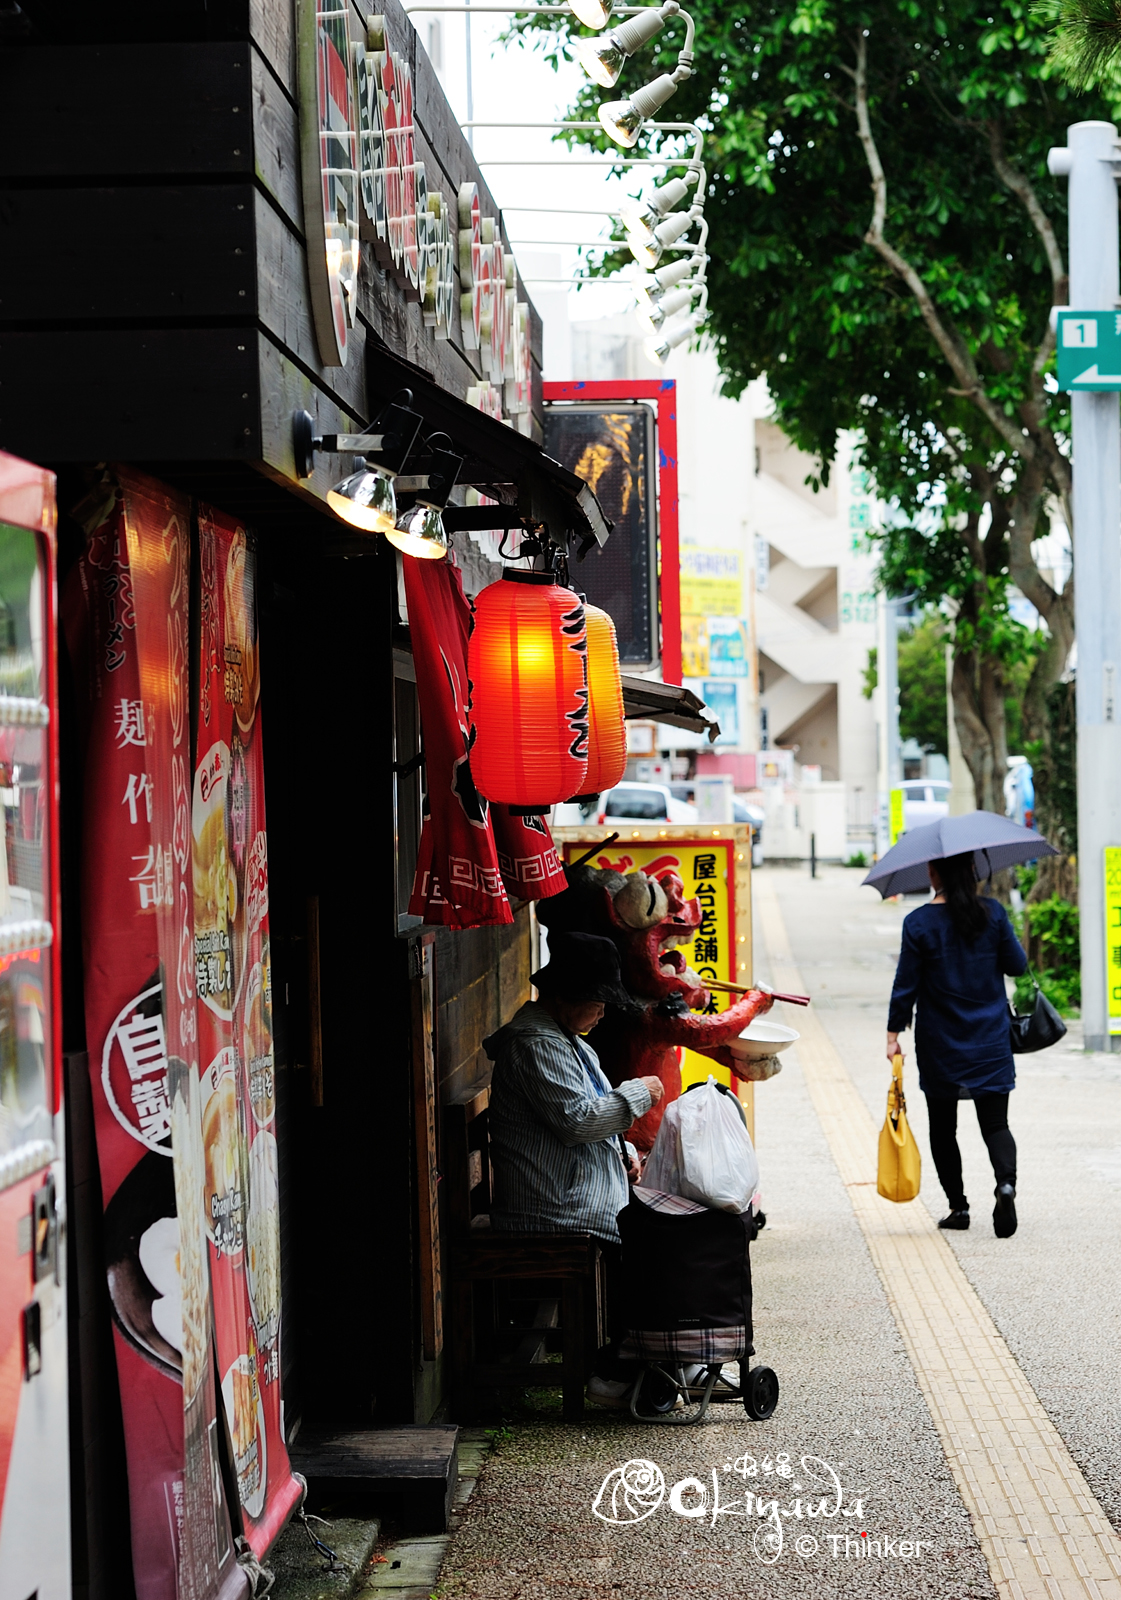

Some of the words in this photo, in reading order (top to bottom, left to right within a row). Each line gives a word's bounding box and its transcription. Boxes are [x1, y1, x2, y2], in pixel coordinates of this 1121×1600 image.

[1075, 323, 1085, 344] 1
[102, 573, 127, 673] ラーメン
